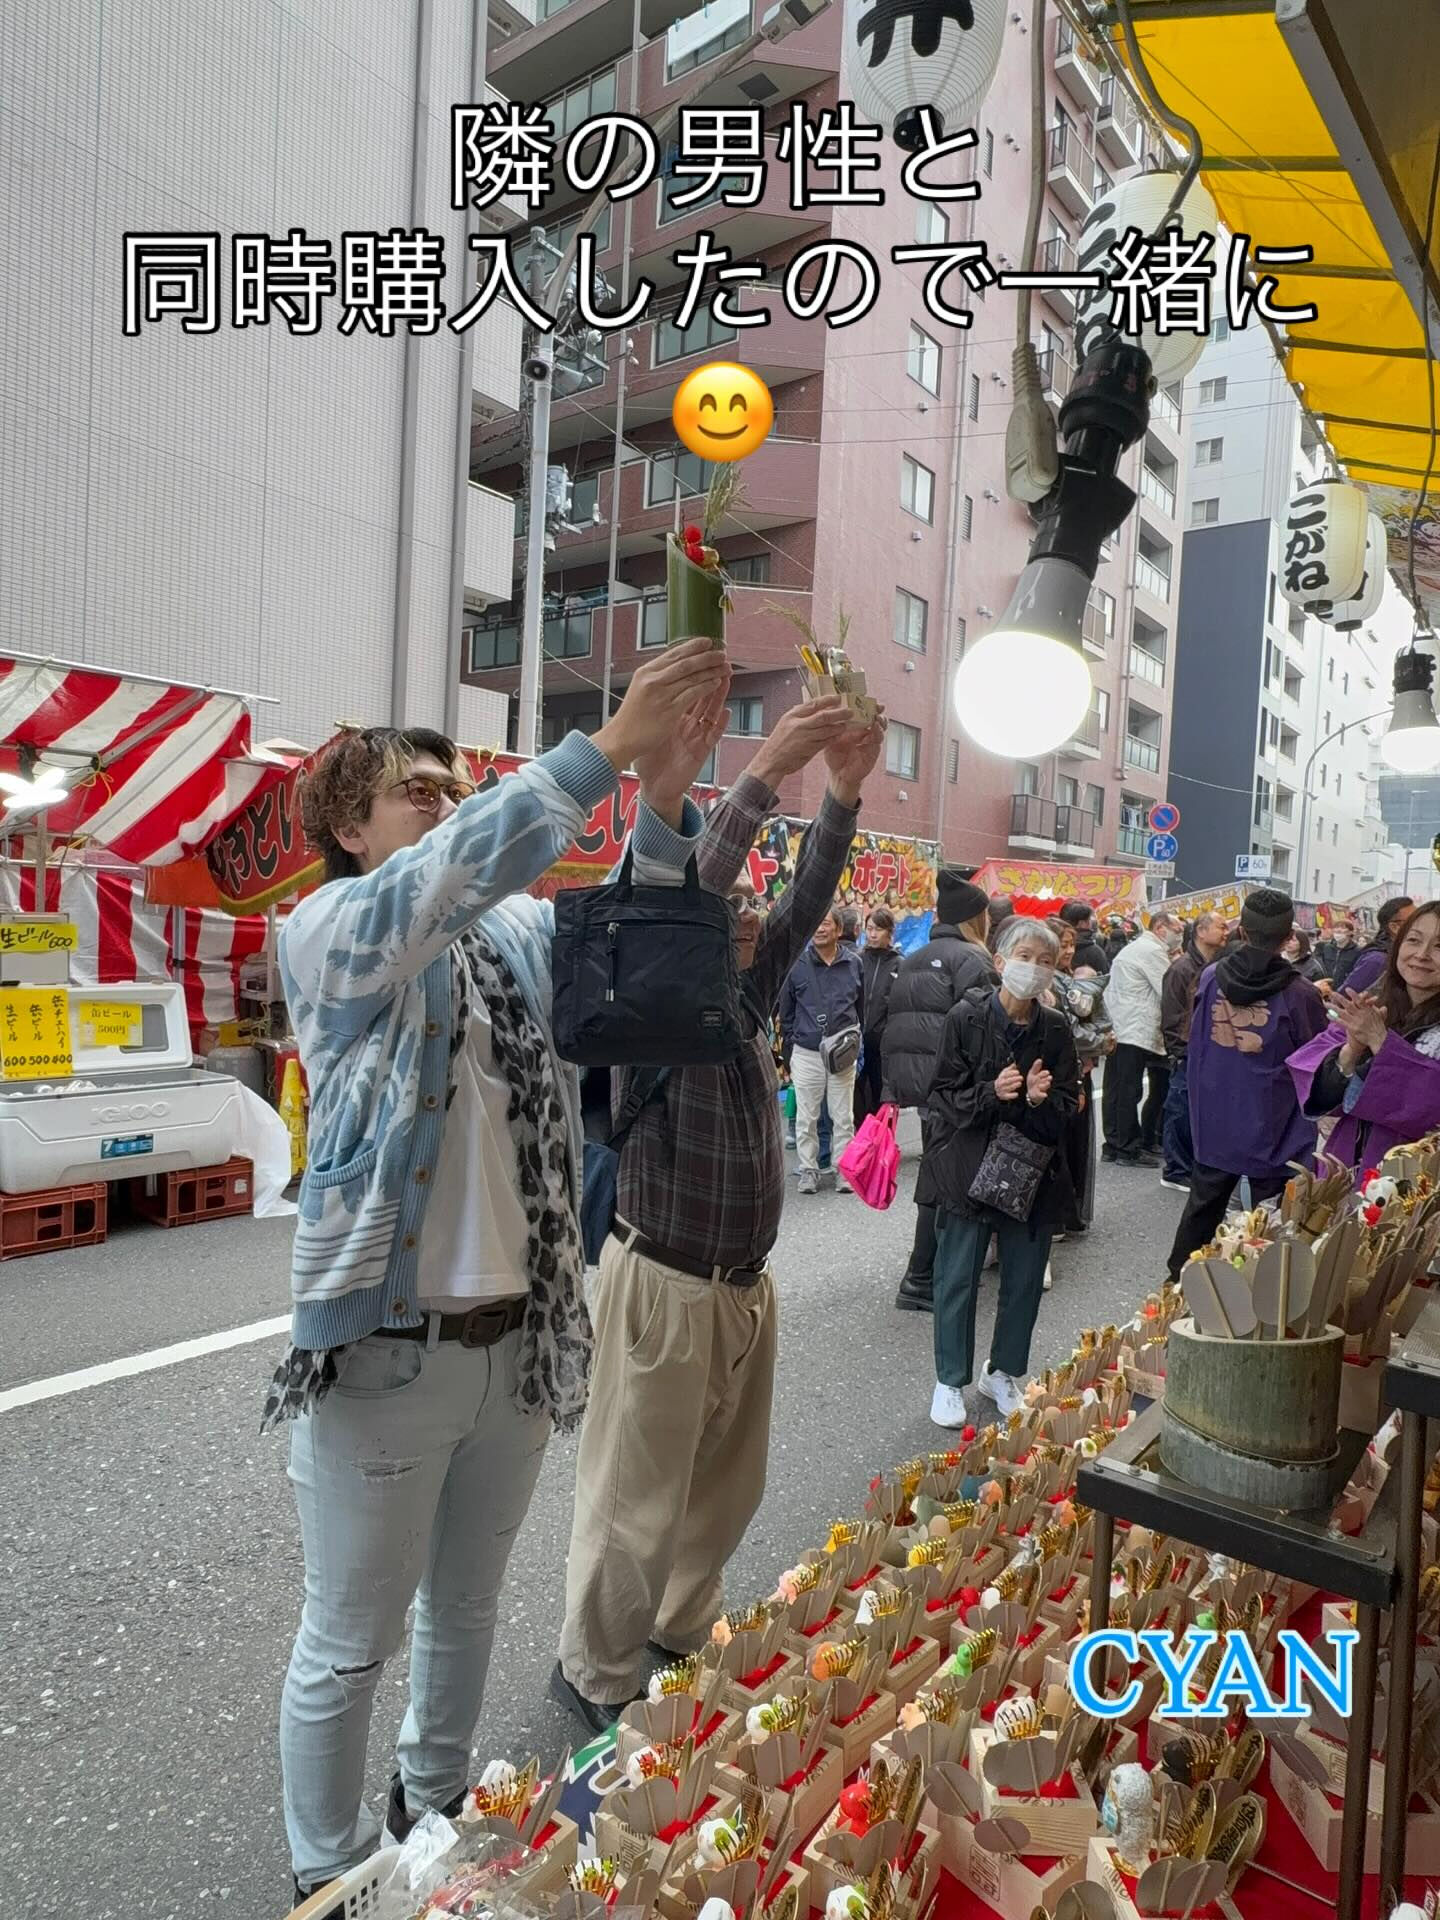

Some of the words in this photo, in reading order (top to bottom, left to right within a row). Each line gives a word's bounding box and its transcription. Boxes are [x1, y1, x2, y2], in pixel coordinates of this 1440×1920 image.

[1284, 493, 1330, 592] こがね
[1153, 839, 1166, 857] P
[851, 848, 912, 898] ポテト
[998, 866, 1134, 899] さかなつり
[0, 927, 55, 949] 生ビール
[48, 936, 73, 949] 600
[91, 1008, 132, 1019] 缶ビール
[3, 1055, 27, 1067] 600
[28, 1055, 50, 1066] 500
[51, 1053, 73, 1065] 400
